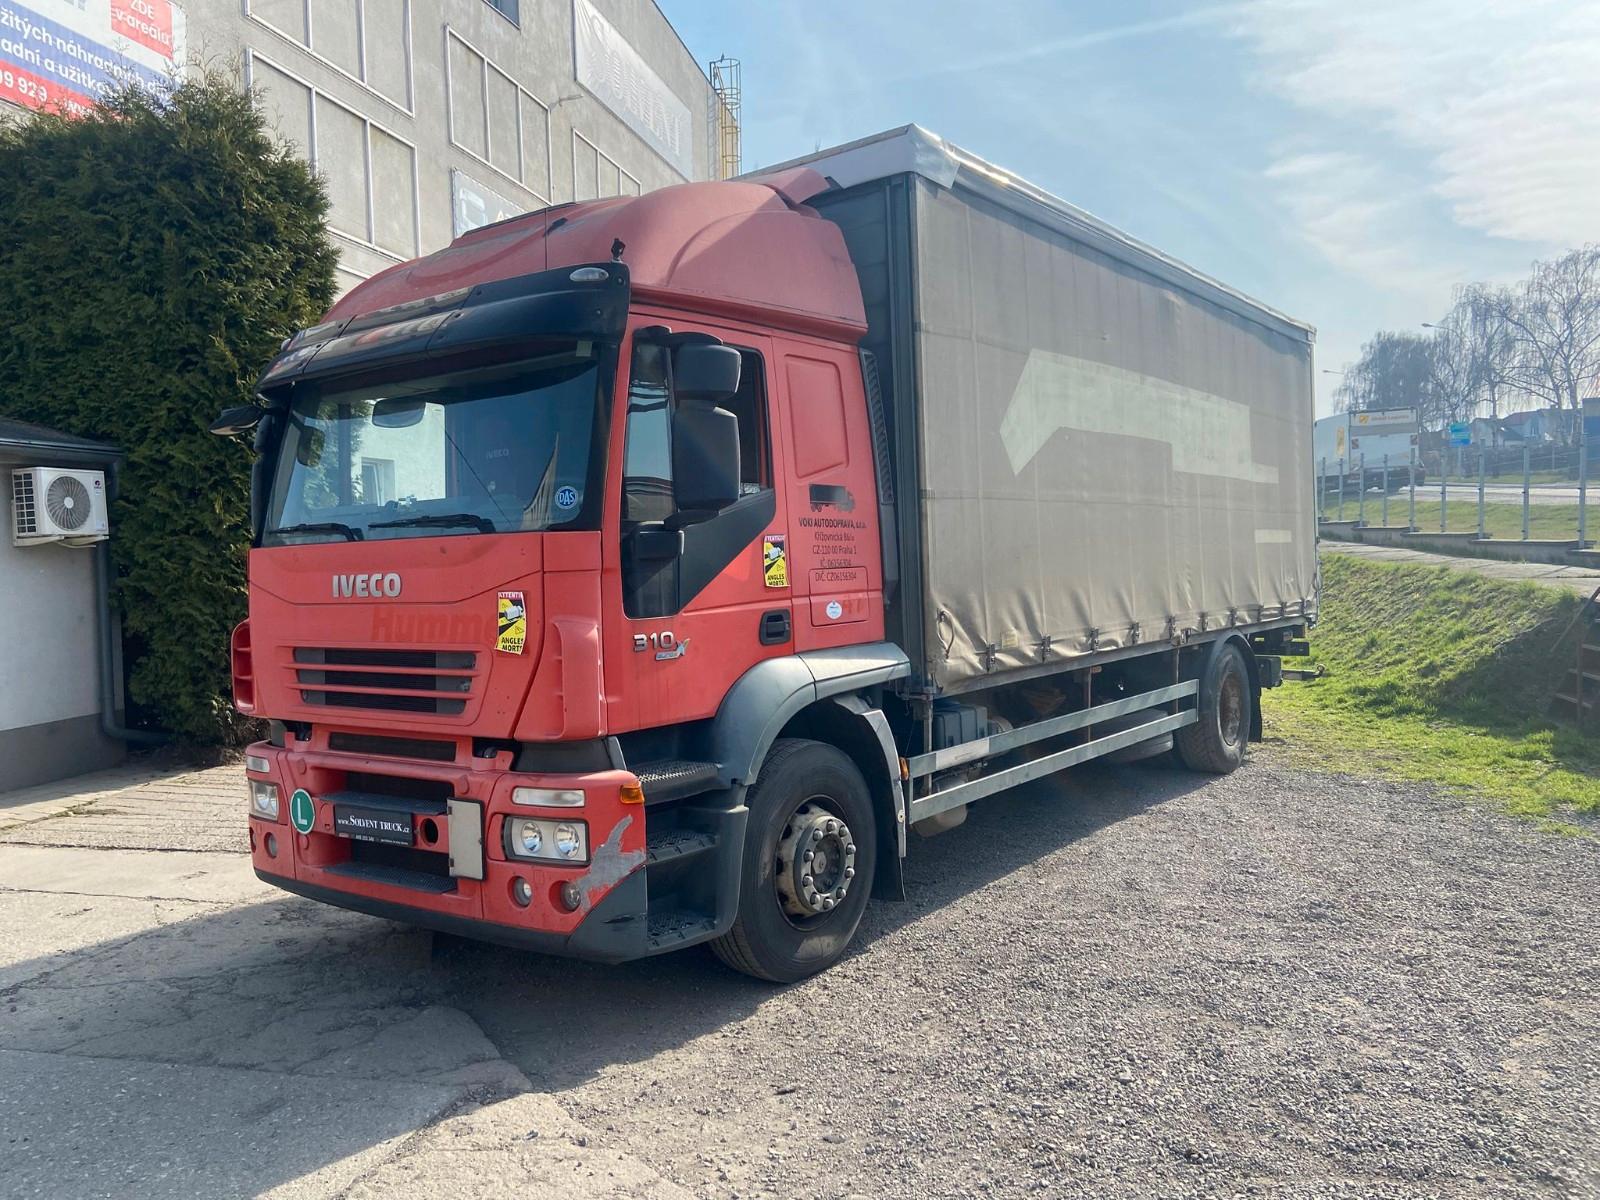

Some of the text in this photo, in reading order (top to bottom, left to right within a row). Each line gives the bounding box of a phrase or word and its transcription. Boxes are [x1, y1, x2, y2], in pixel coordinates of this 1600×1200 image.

[130, 0, 155, 20] ZDE
[0, 7, 53, 46] žitých
[1, 38, 40, 67] adní
[44, 58, 55, 73] a
[0, 69, 14, 89] 9
[559, 491, 575, 505] DAS
[332, 573, 402, 597] IVECO
[633, 631, 674, 652] 310
[297, 798, 308, 825] L
